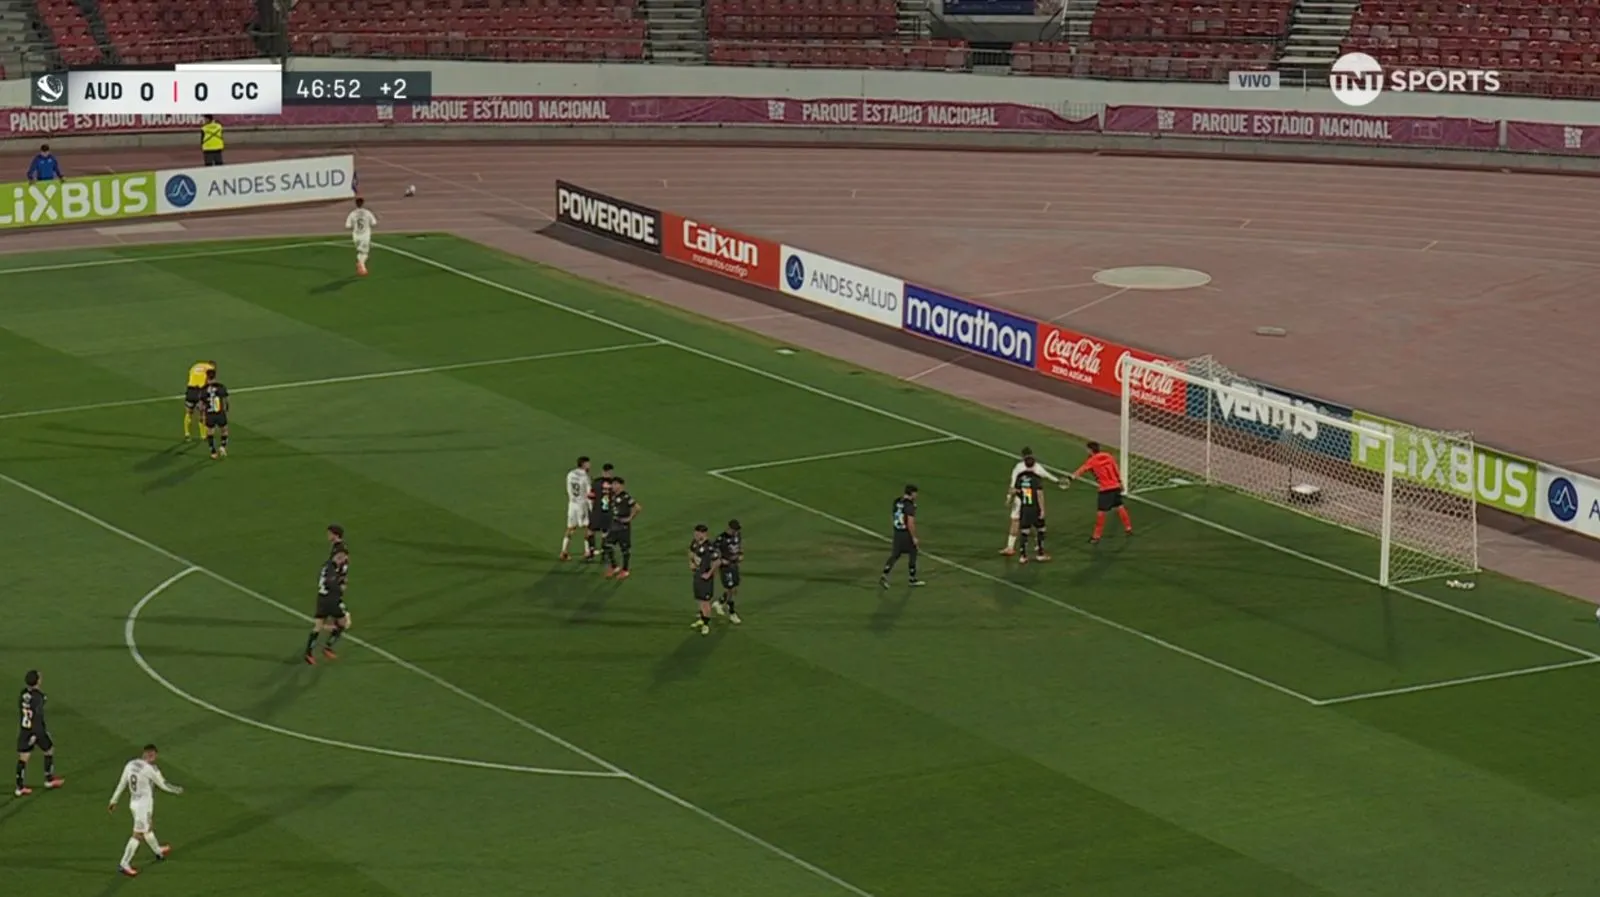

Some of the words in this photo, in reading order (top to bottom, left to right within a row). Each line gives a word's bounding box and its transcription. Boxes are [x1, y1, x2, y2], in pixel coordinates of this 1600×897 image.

[10, 112, 69, 132] PARQUE
[74, 113, 135, 129] ESTADIO
[142, 114, 205, 126] NACIONA
[412, 101, 468, 121] PARQUE
[473, 100, 534, 119] ESTADIO
[539, 100, 611, 119] NACIONAL
[803, 103, 857, 123] PARQUE
[863, 103, 923, 124] ESTADIO
[928, 105, 999, 125] NACIONAL
[1192, 113, 1248, 134] PARQUE
[1253, 114, 1314, 136] ESTADIO
[1319, 117, 1392, 139] NACIONAL
[208, 175, 276, 197] ANDES
[280, 169, 346, 191] SALUD
[558, 188, 656, 245] POWERADE
[683, 219, 758, 267] Caixun
[810, 269, 853, 299] ANDES
[855, 281, 898, 312] SALUD
[907, 295, 1032, 362] marathon
[1043, 329, 1104, 375] Coca-Cola
